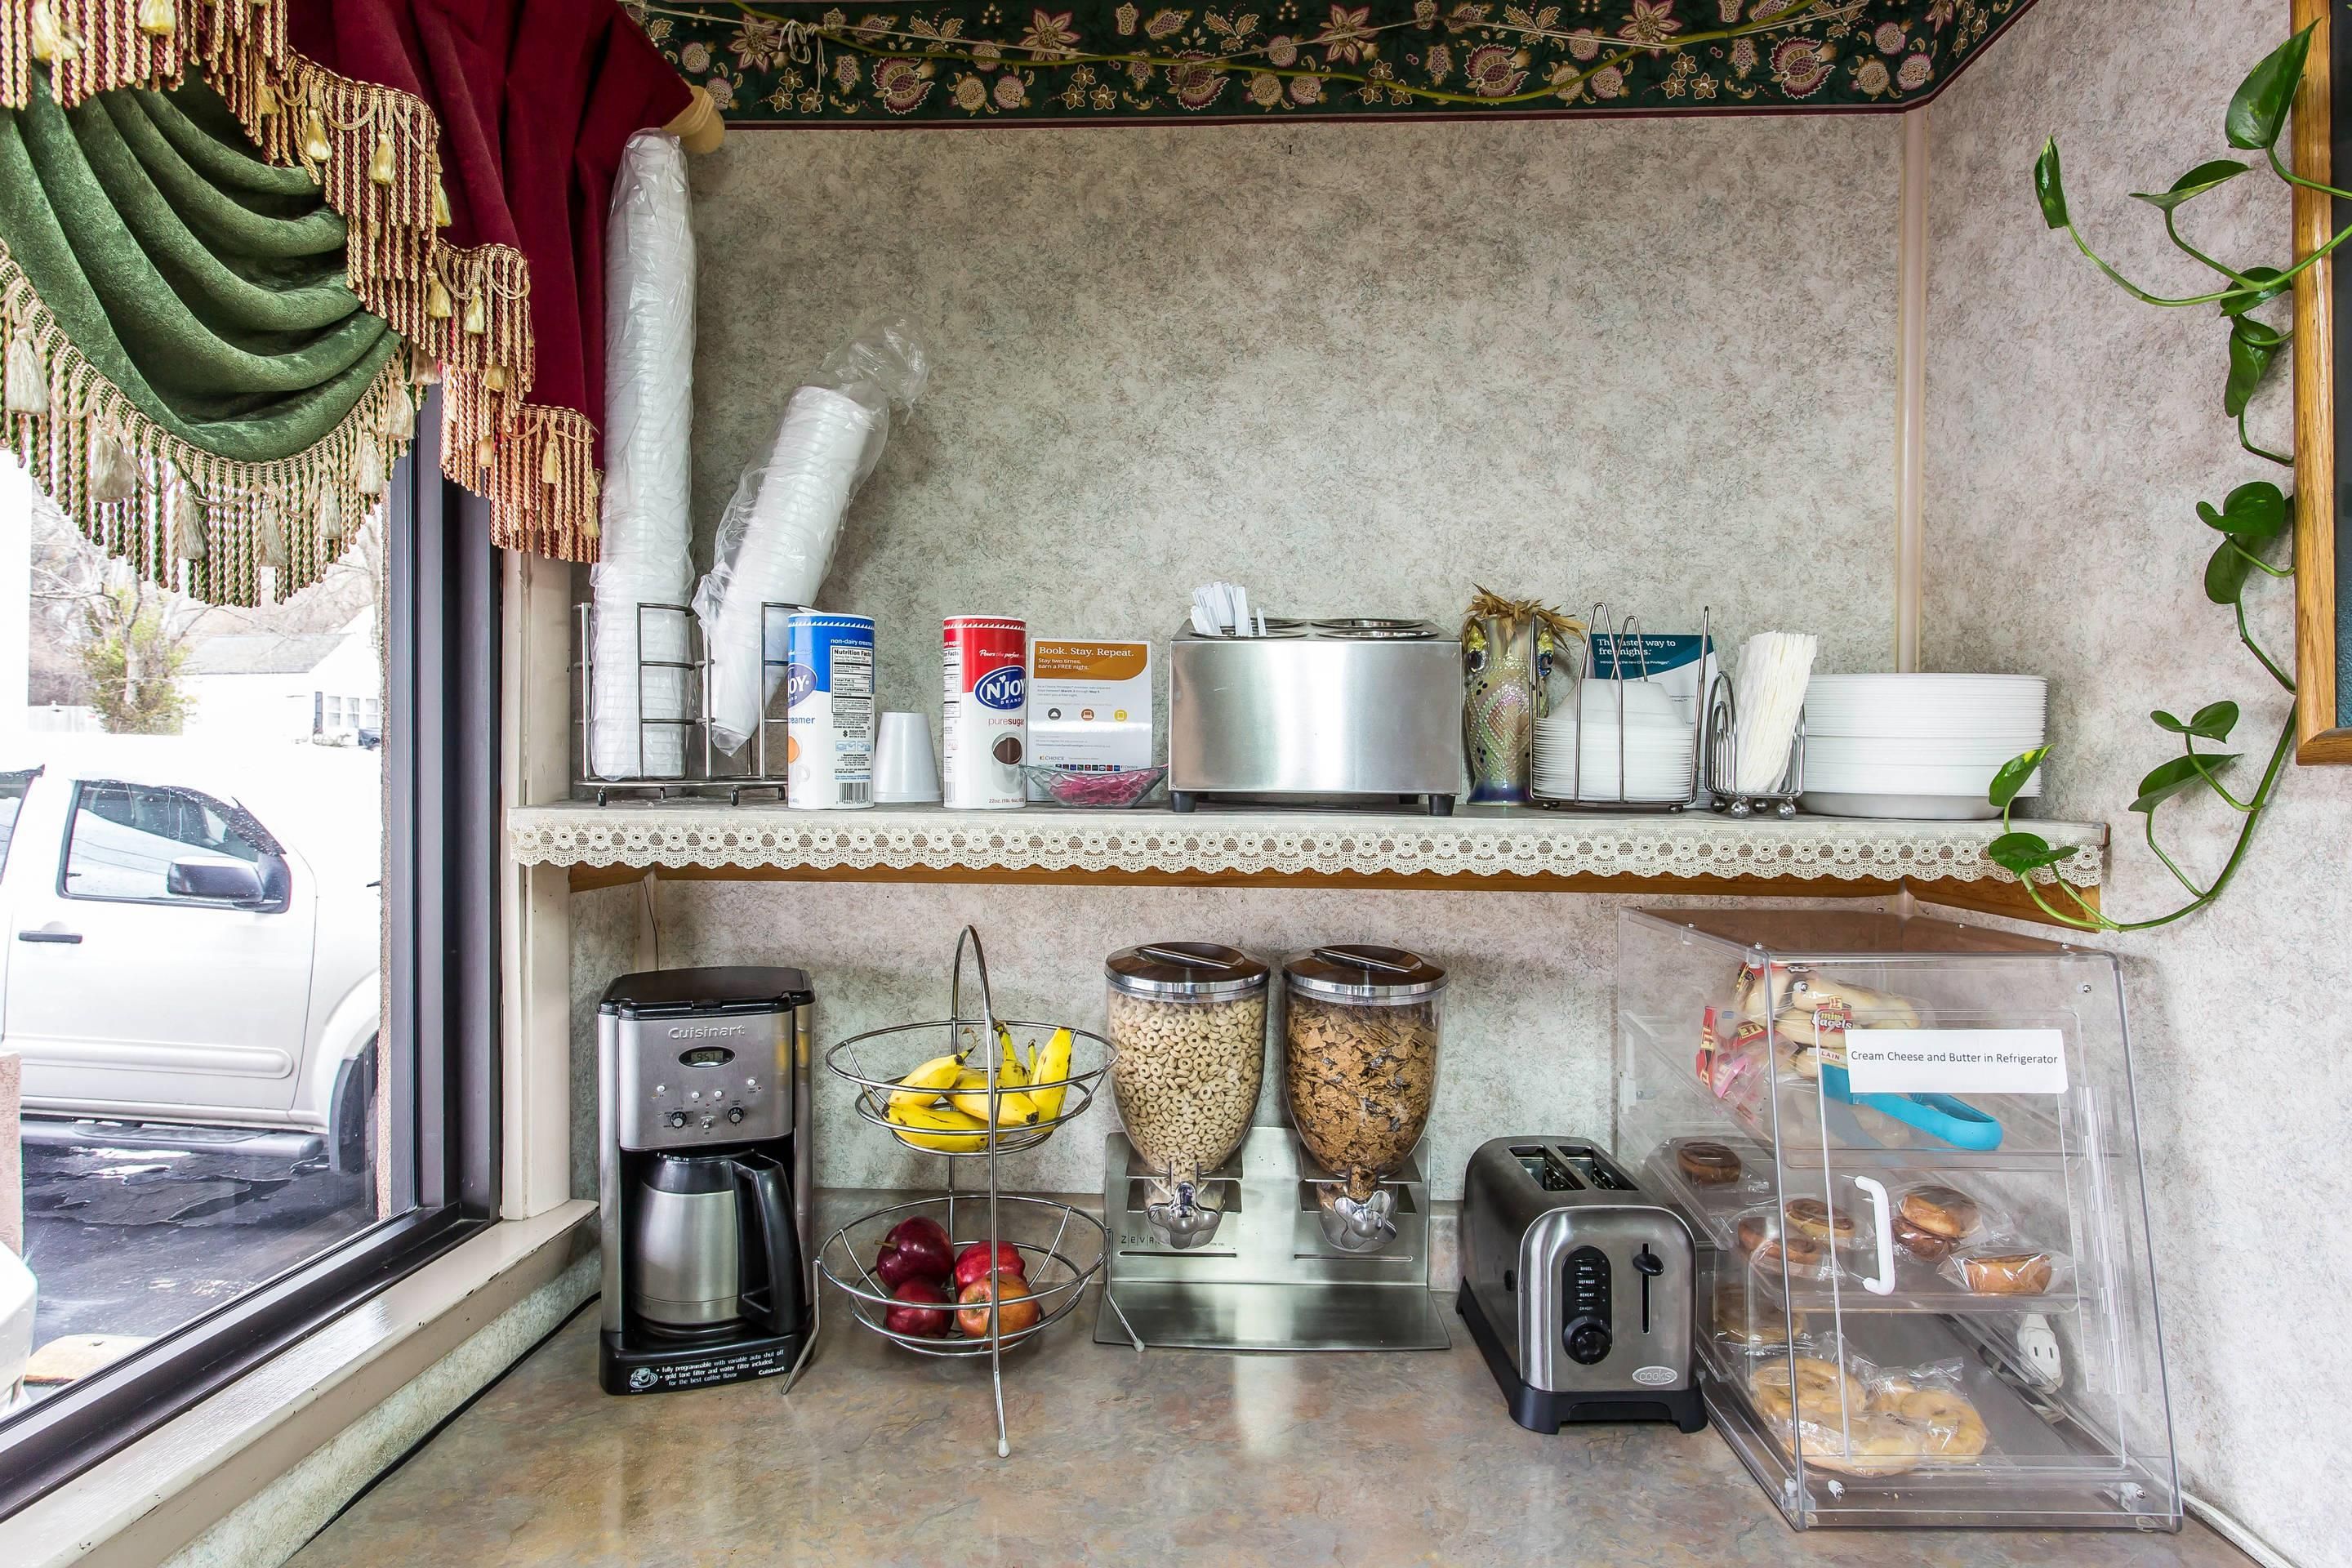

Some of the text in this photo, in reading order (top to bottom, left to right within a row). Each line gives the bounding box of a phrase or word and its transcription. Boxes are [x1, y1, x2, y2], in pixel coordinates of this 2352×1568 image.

[1039, 646, 1134, 658] Book. Stay. Repeat.
[1599, 647, 1651, 657] fre nighs.
[668, 1024, 746, 1040] Cuisinart
[1820, 1050, 1841, 1061] LAIN
[1851, 1050, 2058, 1065] Cream Cheese and Butter in Refrigerator
[665, 1373, 677, 1381] gold
[693, 1368, 706, 1376] filter
[707, 1366, 718, 1374] and
[719, 1365, 735, 1373] water
[737, 1362, 750, 1370] filter
[751, 1358, 773, 1368] included.
[675, 1361, 712, 1373] programmable
[728, 1356, 748, 1365] variable
[758, 1365, 785, 1376] Cuisinart
[668, 1379, 677, 1387] for
[704, 1374, 721, 1382] coffee
[723, 1372, 737, 1380] flavor
[1639, 1369, 1673, 1381] cooks
